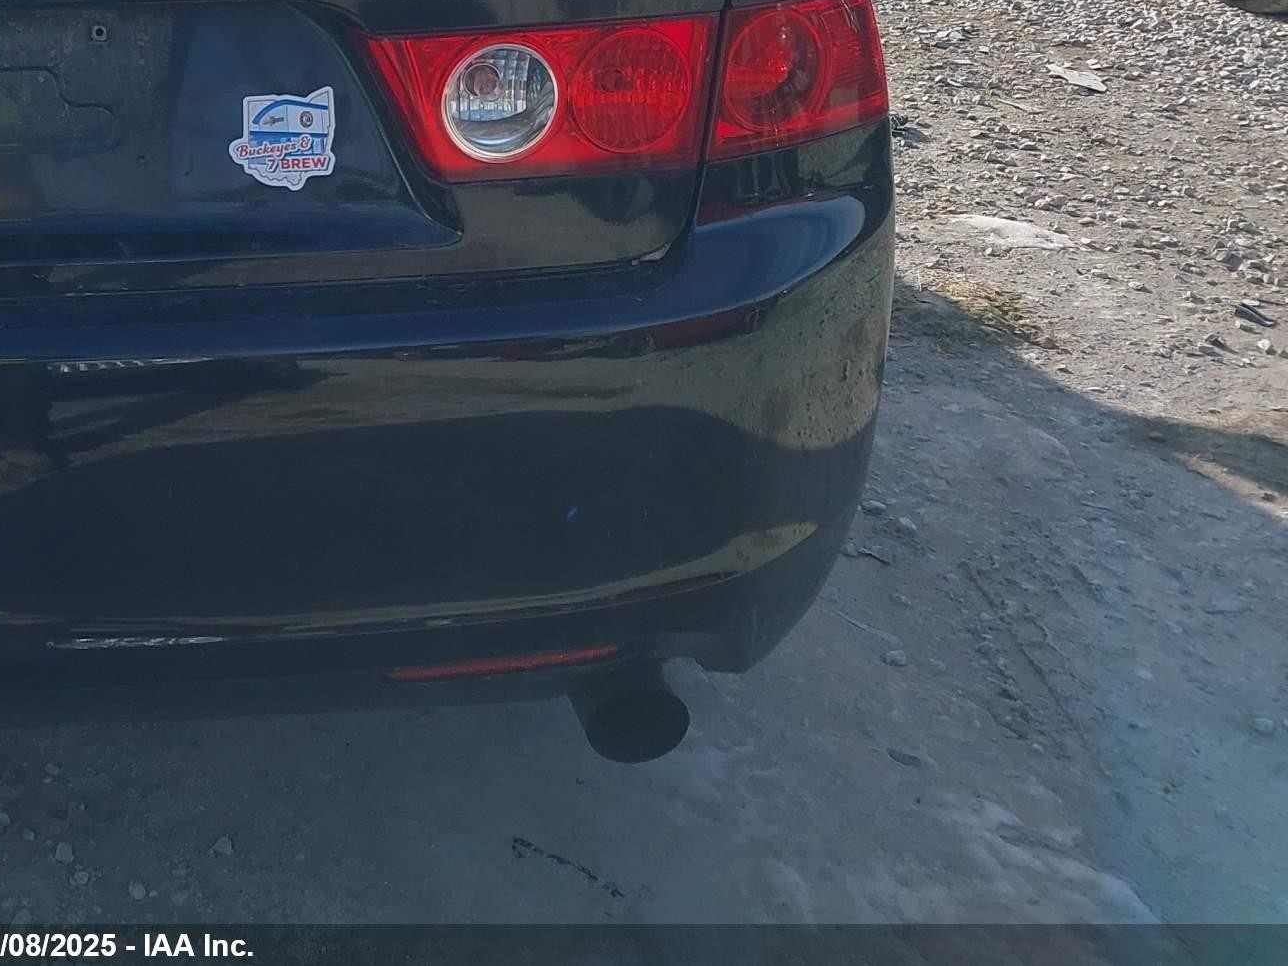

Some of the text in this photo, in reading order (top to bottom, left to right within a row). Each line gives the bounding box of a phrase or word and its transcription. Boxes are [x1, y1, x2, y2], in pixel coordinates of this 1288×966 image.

[236, 135, 311, 160] Buckeyes &
[267, 157, 327, 171] 7 BREW
